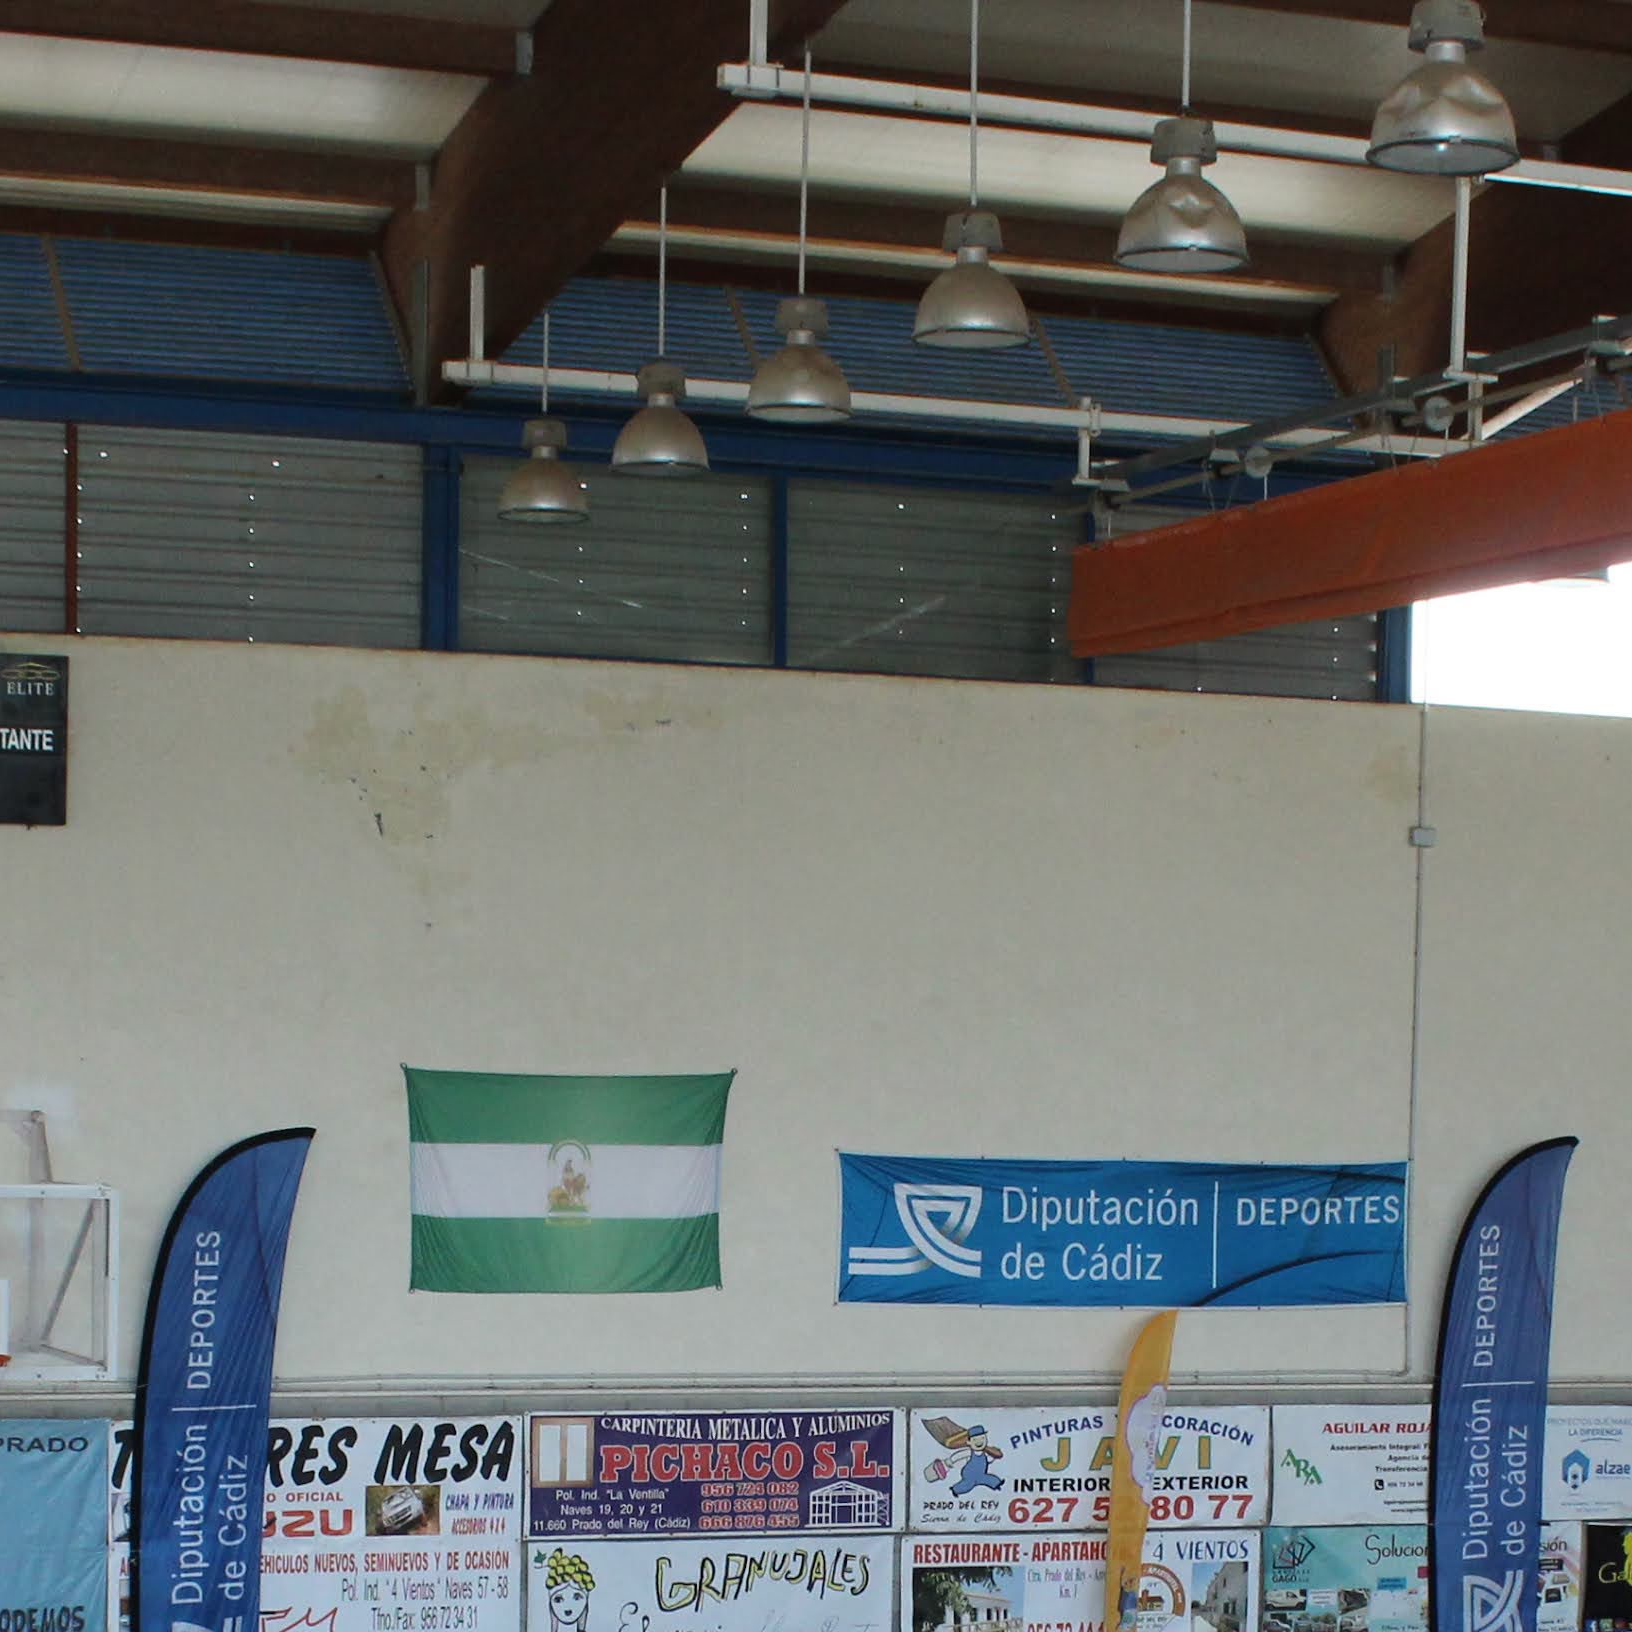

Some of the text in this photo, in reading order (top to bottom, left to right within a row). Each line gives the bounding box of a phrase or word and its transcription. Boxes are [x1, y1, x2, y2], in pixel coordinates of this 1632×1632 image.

[7, 681, 54, 695] ELITE
[1002, 1186, 1197, 1231] Diputación
[1237, 1196, 1400, 1225] DEPORTES
[1002, 1242, 1162, 1280] de Cádiz
[188, 1230, 221, 1389] DEPORTES
[1473, 1225, 1500, 1366] DEPORTES
[600, 1412, 891, 1441] CARPINTERIA METALICA Y ALUMINIOS
[1010, 1415, 1104, 1450] PINTURAS
[1322, 1423, 1390, 1434] AGUILAR
[374, 1421, 515, 1486] MESA
[600, 1441, 890, 1483] PICHACO S.L.
[1280, 1448, 1323, 1485] ARA
[1595, 1460, 1631, 1475] alzae
[285, 1491, 343, 1502] OFICIAL
[1014, 1477, 1112, 1493] INTERIOR
[1463, 1398, 1492, 1560] Diputación
[1500, 1424, 1528, 1555] de Cádiz
[172, 1424, 206, 1604] Diputación
[1008, 1494, 1254, 1523] 627 80 77
[219, 1455, 248, 1600] de Cádiz
[913, 1543, 1020, 1564] RESTAURANTE
[1175, 1539, 1249, 1560] VIENTOS
[342, 1576, 508, 1601] Pol. Ind. Naves 57 58
[655, 1548, 870, 1612] GRANUJALES
